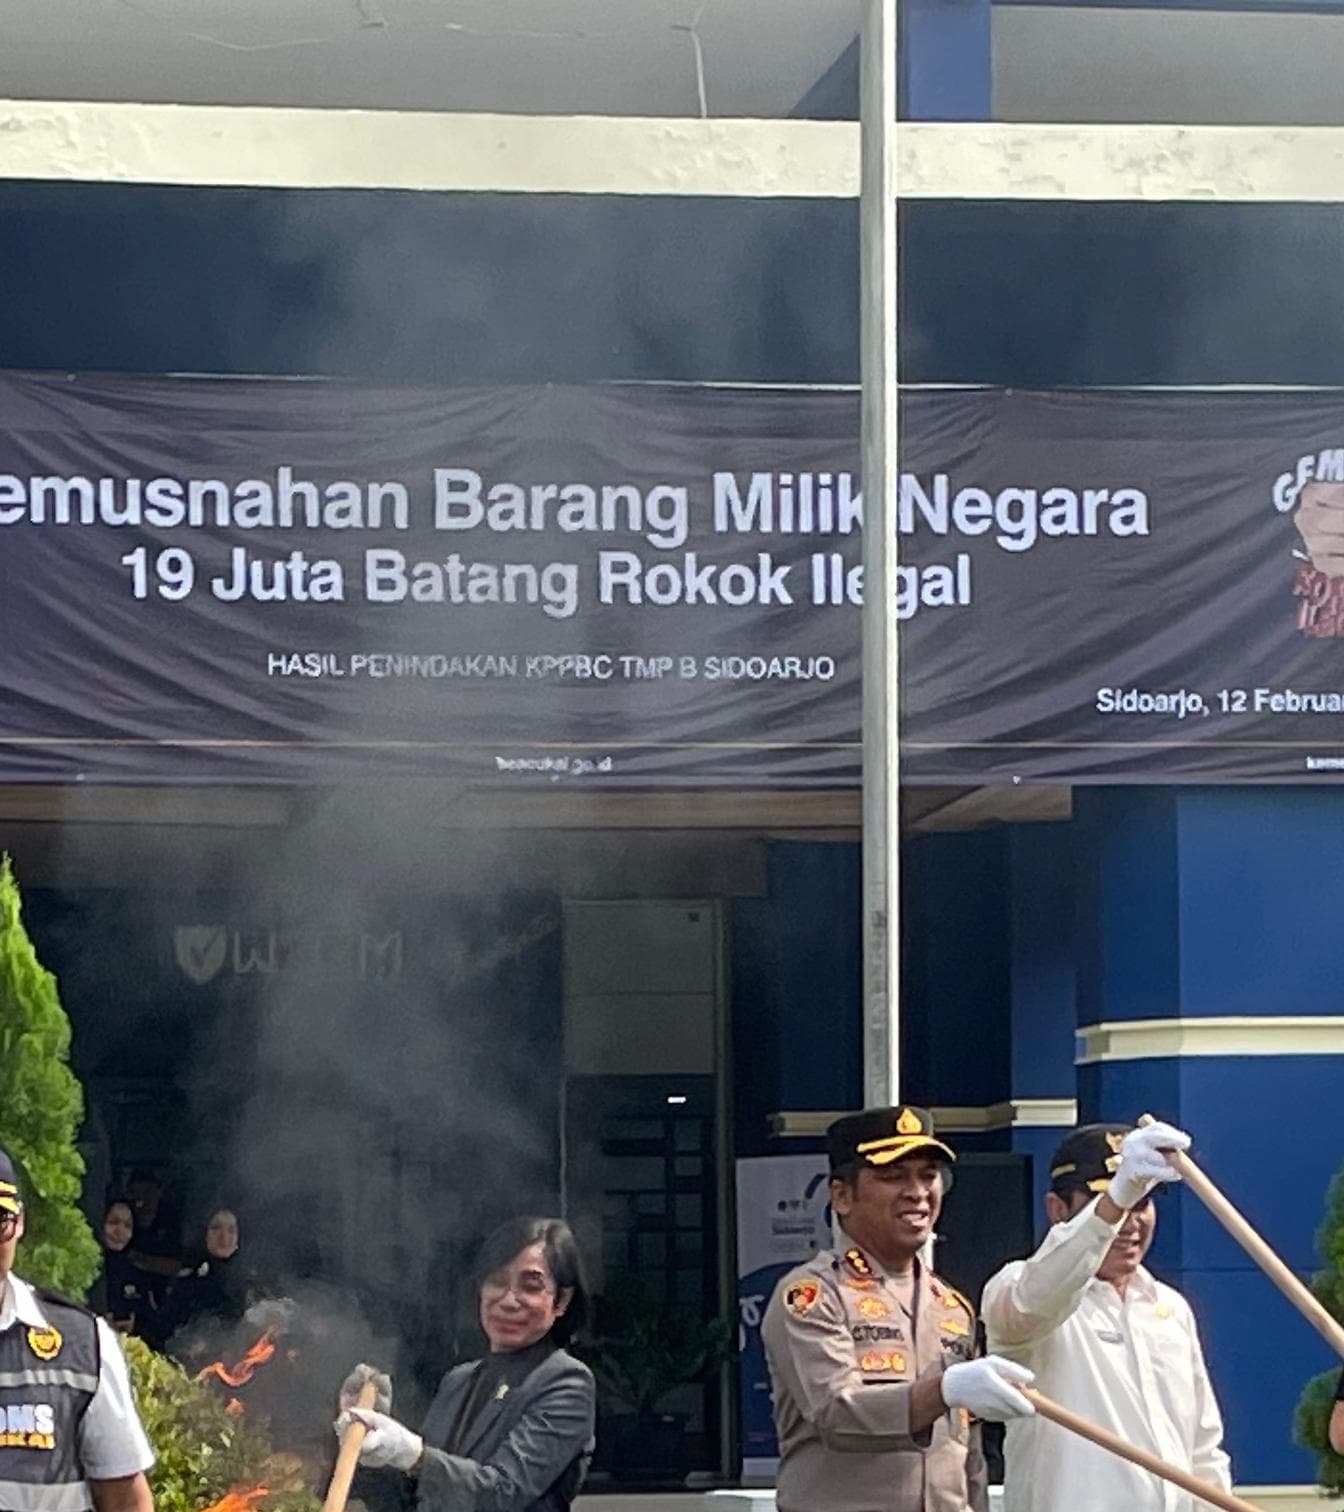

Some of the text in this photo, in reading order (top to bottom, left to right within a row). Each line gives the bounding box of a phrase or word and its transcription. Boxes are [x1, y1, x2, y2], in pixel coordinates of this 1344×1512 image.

[434, 467, 688, 549] Barang
[713, 472, 864, 534] Milik
[898, 473, 1150, 552] Negara
[122, 547, 971, 620] 19 Juta Batang Rokok Ilegal
[267, 653, 835, 680] HASIL PENINDAKAN KPPBC TMP B SIDOARJO
[1096, 688, 1210, 719] Sidoarjo,
[1217, 690, 1247, 712] 12
